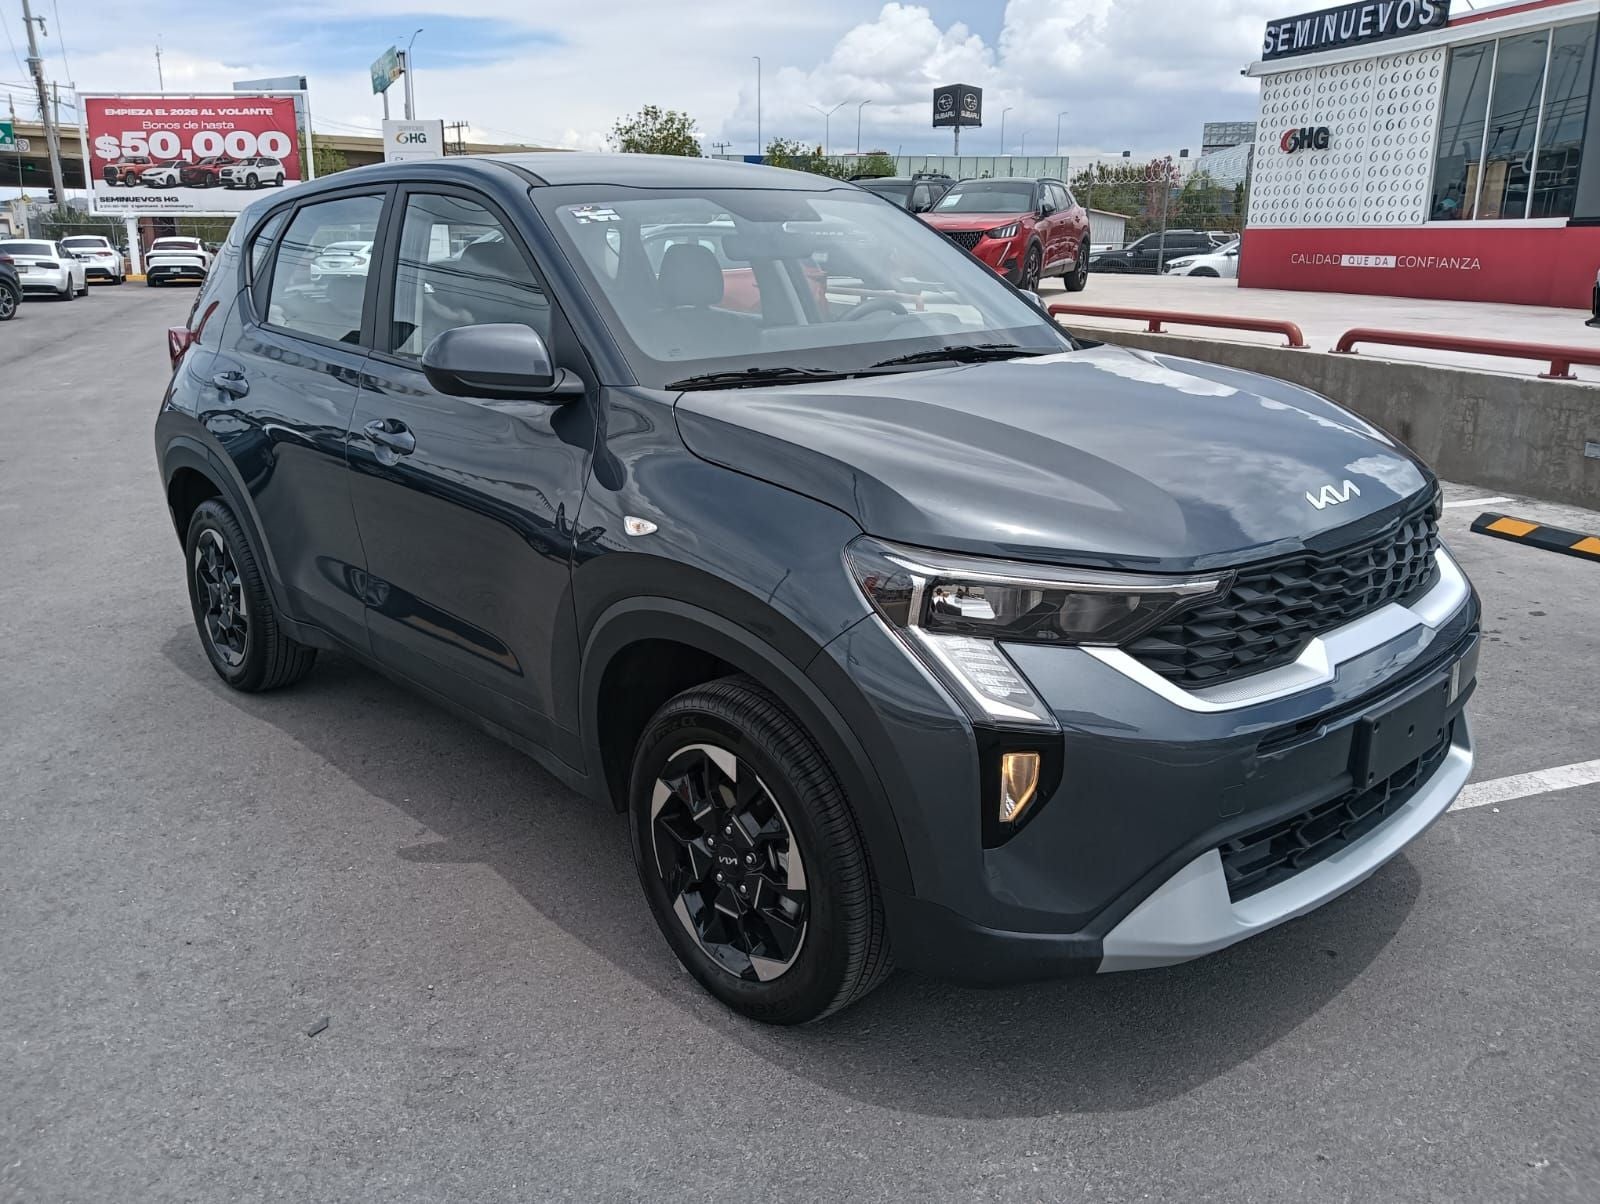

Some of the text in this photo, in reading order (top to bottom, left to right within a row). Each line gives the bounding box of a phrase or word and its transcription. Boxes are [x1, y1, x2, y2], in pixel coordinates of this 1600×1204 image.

[1264, 0, 1434, 54] SEMINUEVOS
[104, 108, 273, 116] EMPIEZA EL 2026 AL VOLANTE
[142, 120, 235, 130] Bonos de hasta
[409, 132, 427, 144] HG
[1299, 126, 1330, 150] HG
[94, 131, 292, 163] $50,000
[1291, 253, 1481, 270] CALIDAD QUE DA CONFIANZA
